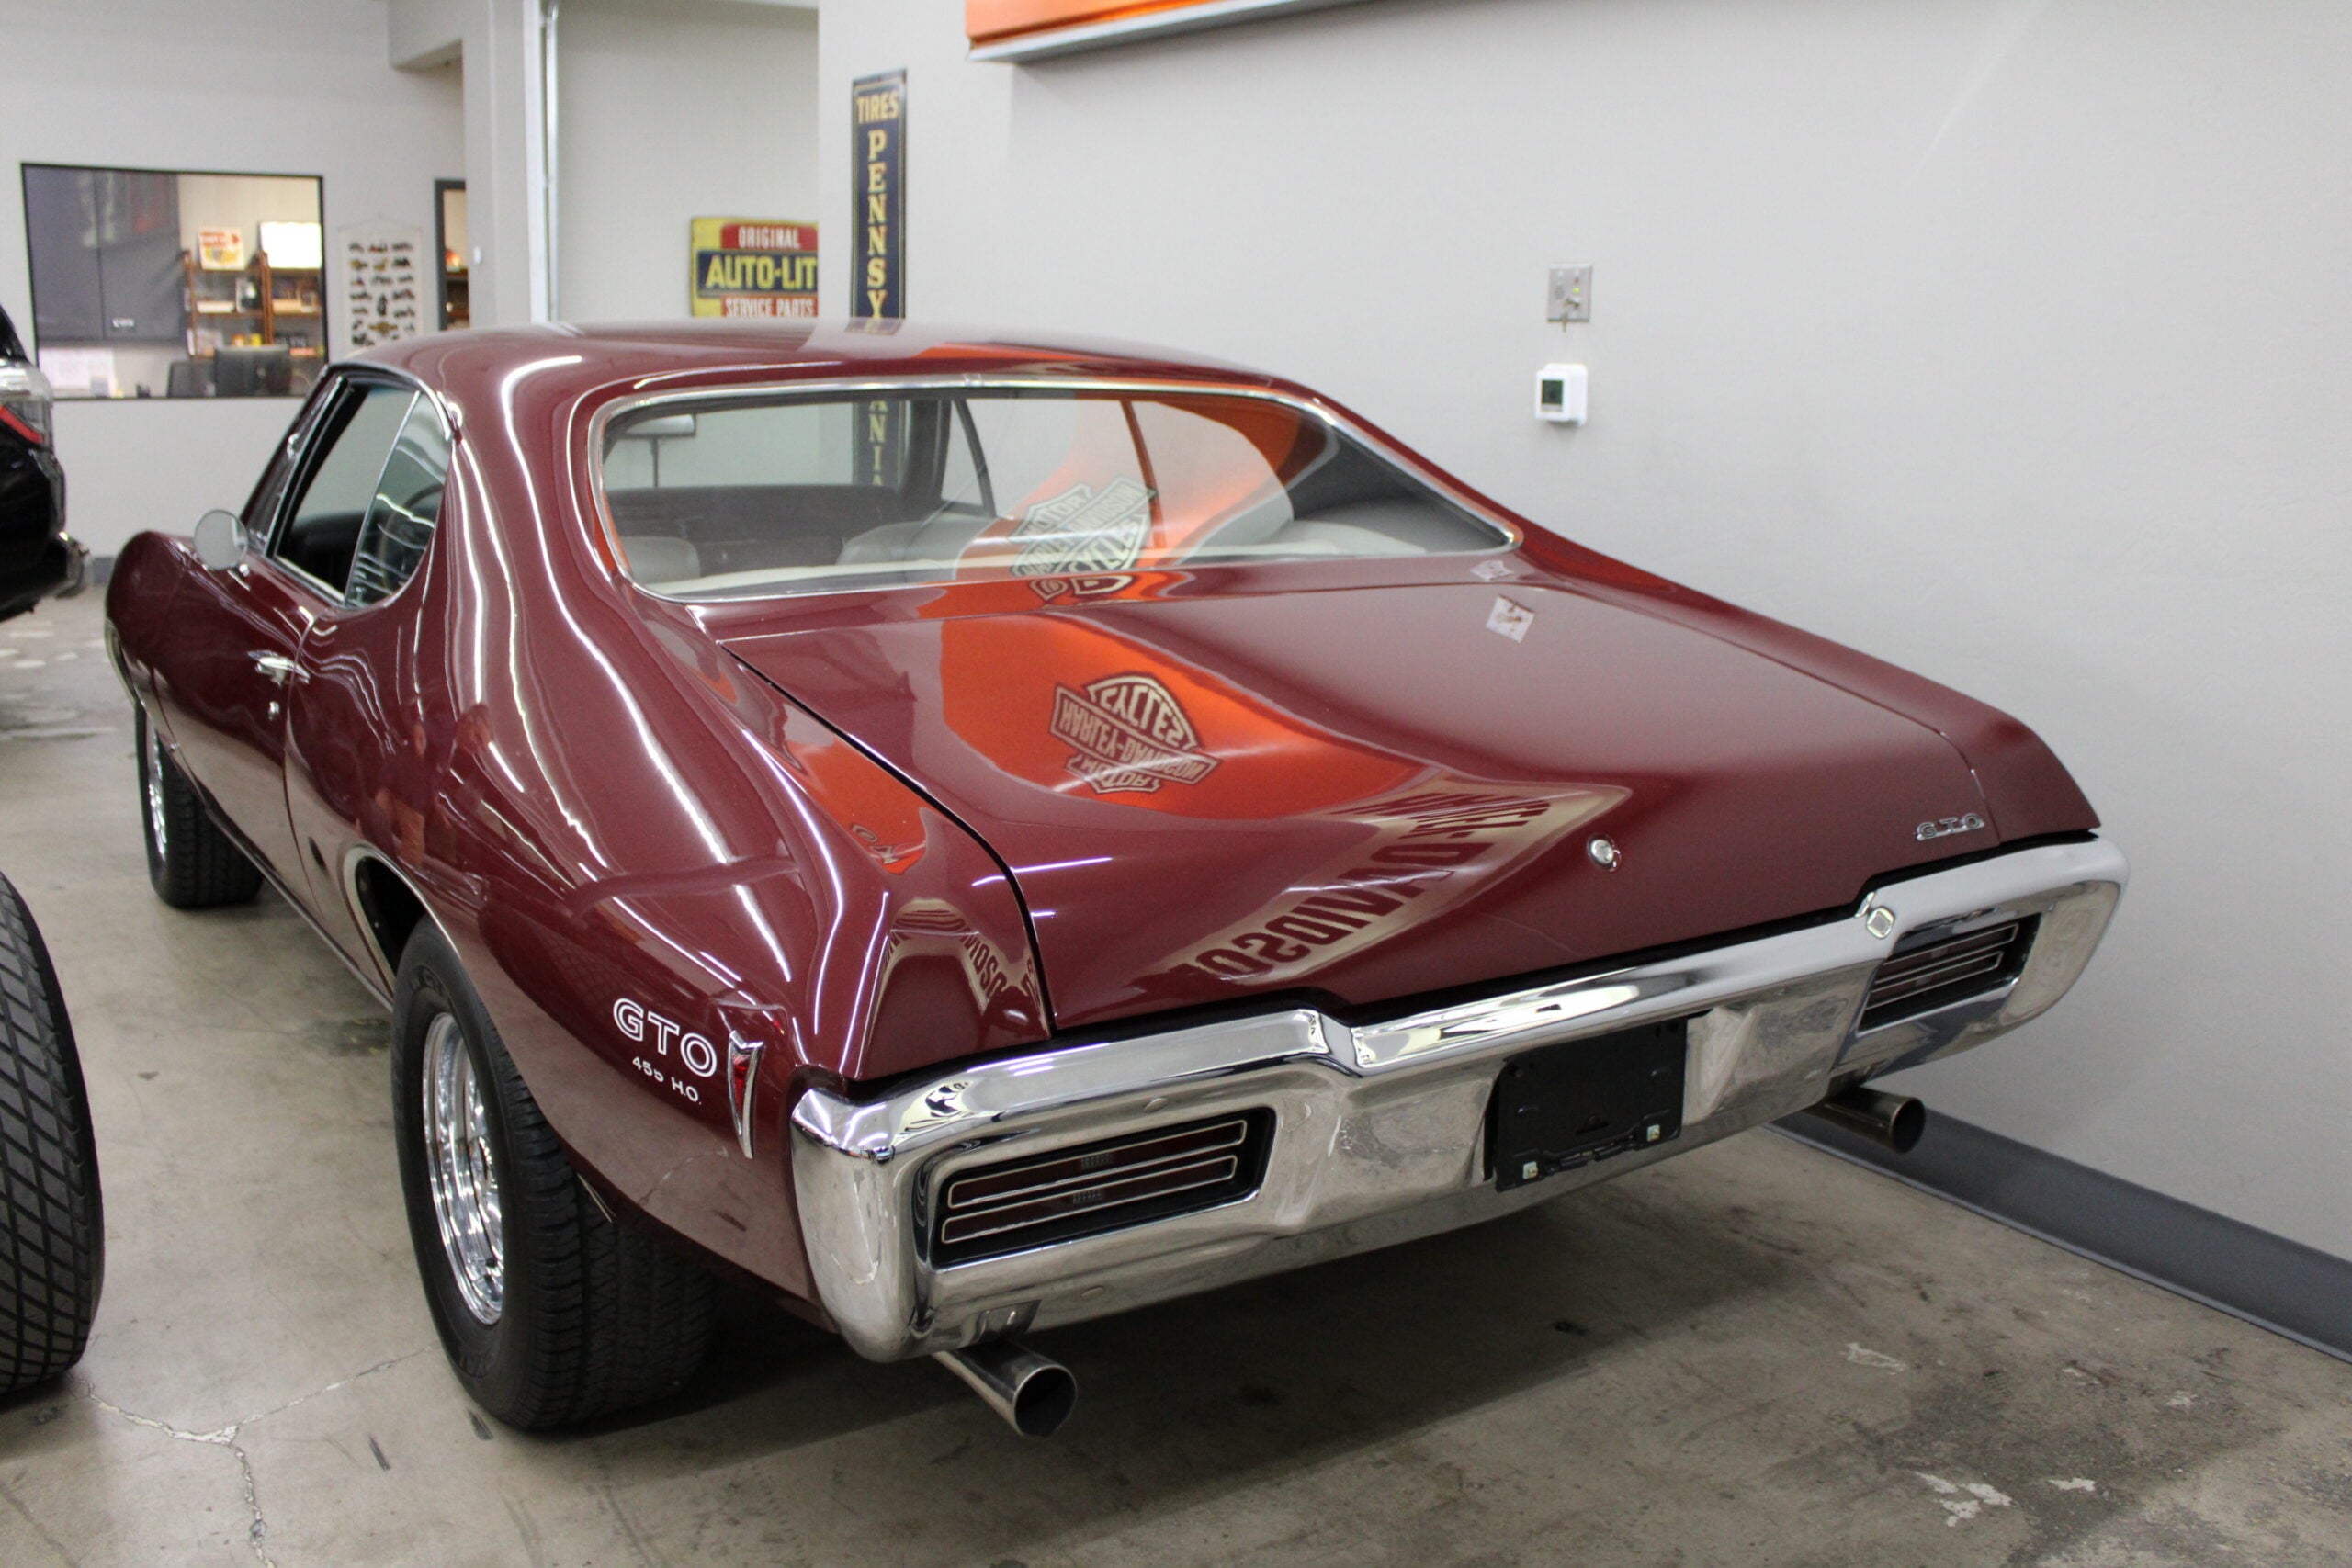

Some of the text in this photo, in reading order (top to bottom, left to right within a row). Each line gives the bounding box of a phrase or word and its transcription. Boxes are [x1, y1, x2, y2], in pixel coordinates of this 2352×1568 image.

[857, 91, 899, 124] TIRES
[738, 227, 801, 249] ORIGINAL
[725, 298, 815, 318] SERVICE PARTS
[1917, 813, 1984, 840] GTO
[613, 998, 718, 1077] GTO
